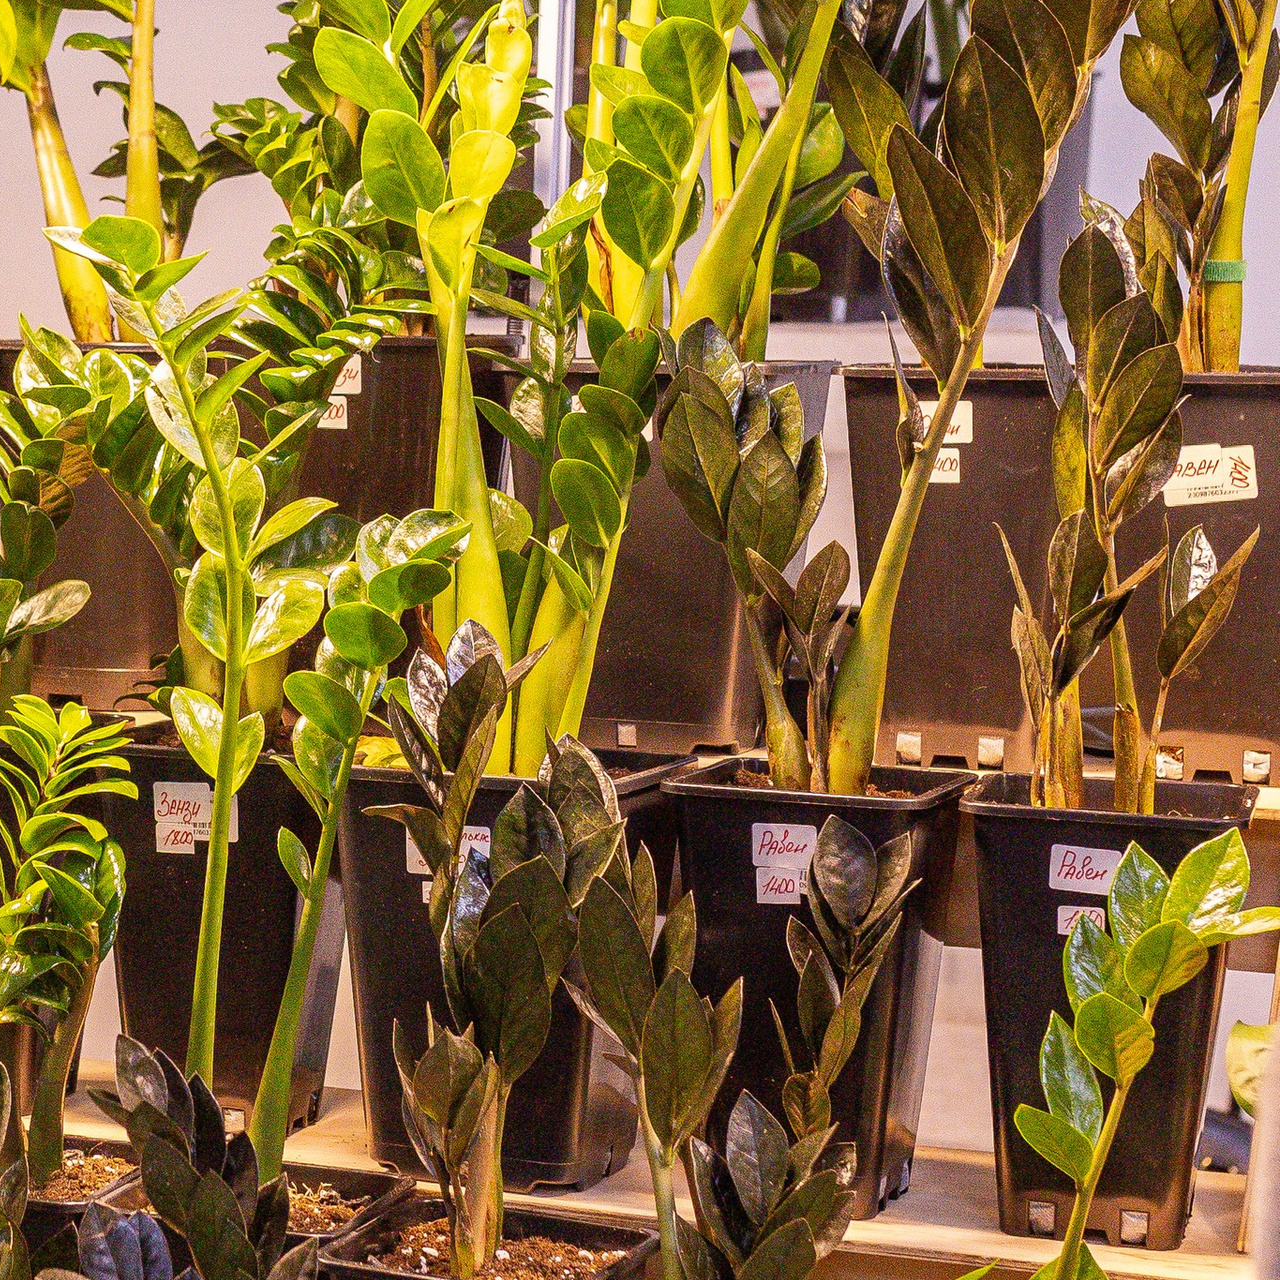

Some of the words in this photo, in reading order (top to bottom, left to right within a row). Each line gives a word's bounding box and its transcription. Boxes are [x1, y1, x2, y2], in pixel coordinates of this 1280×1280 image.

[157, 791, 201, 825] Зензи
[163, 829, 194, 846] 1800
[758, 829, 808, 856] Равен
[1057, 850, 1108, 880] Равен
[762, 875, 795, 896] 1400
